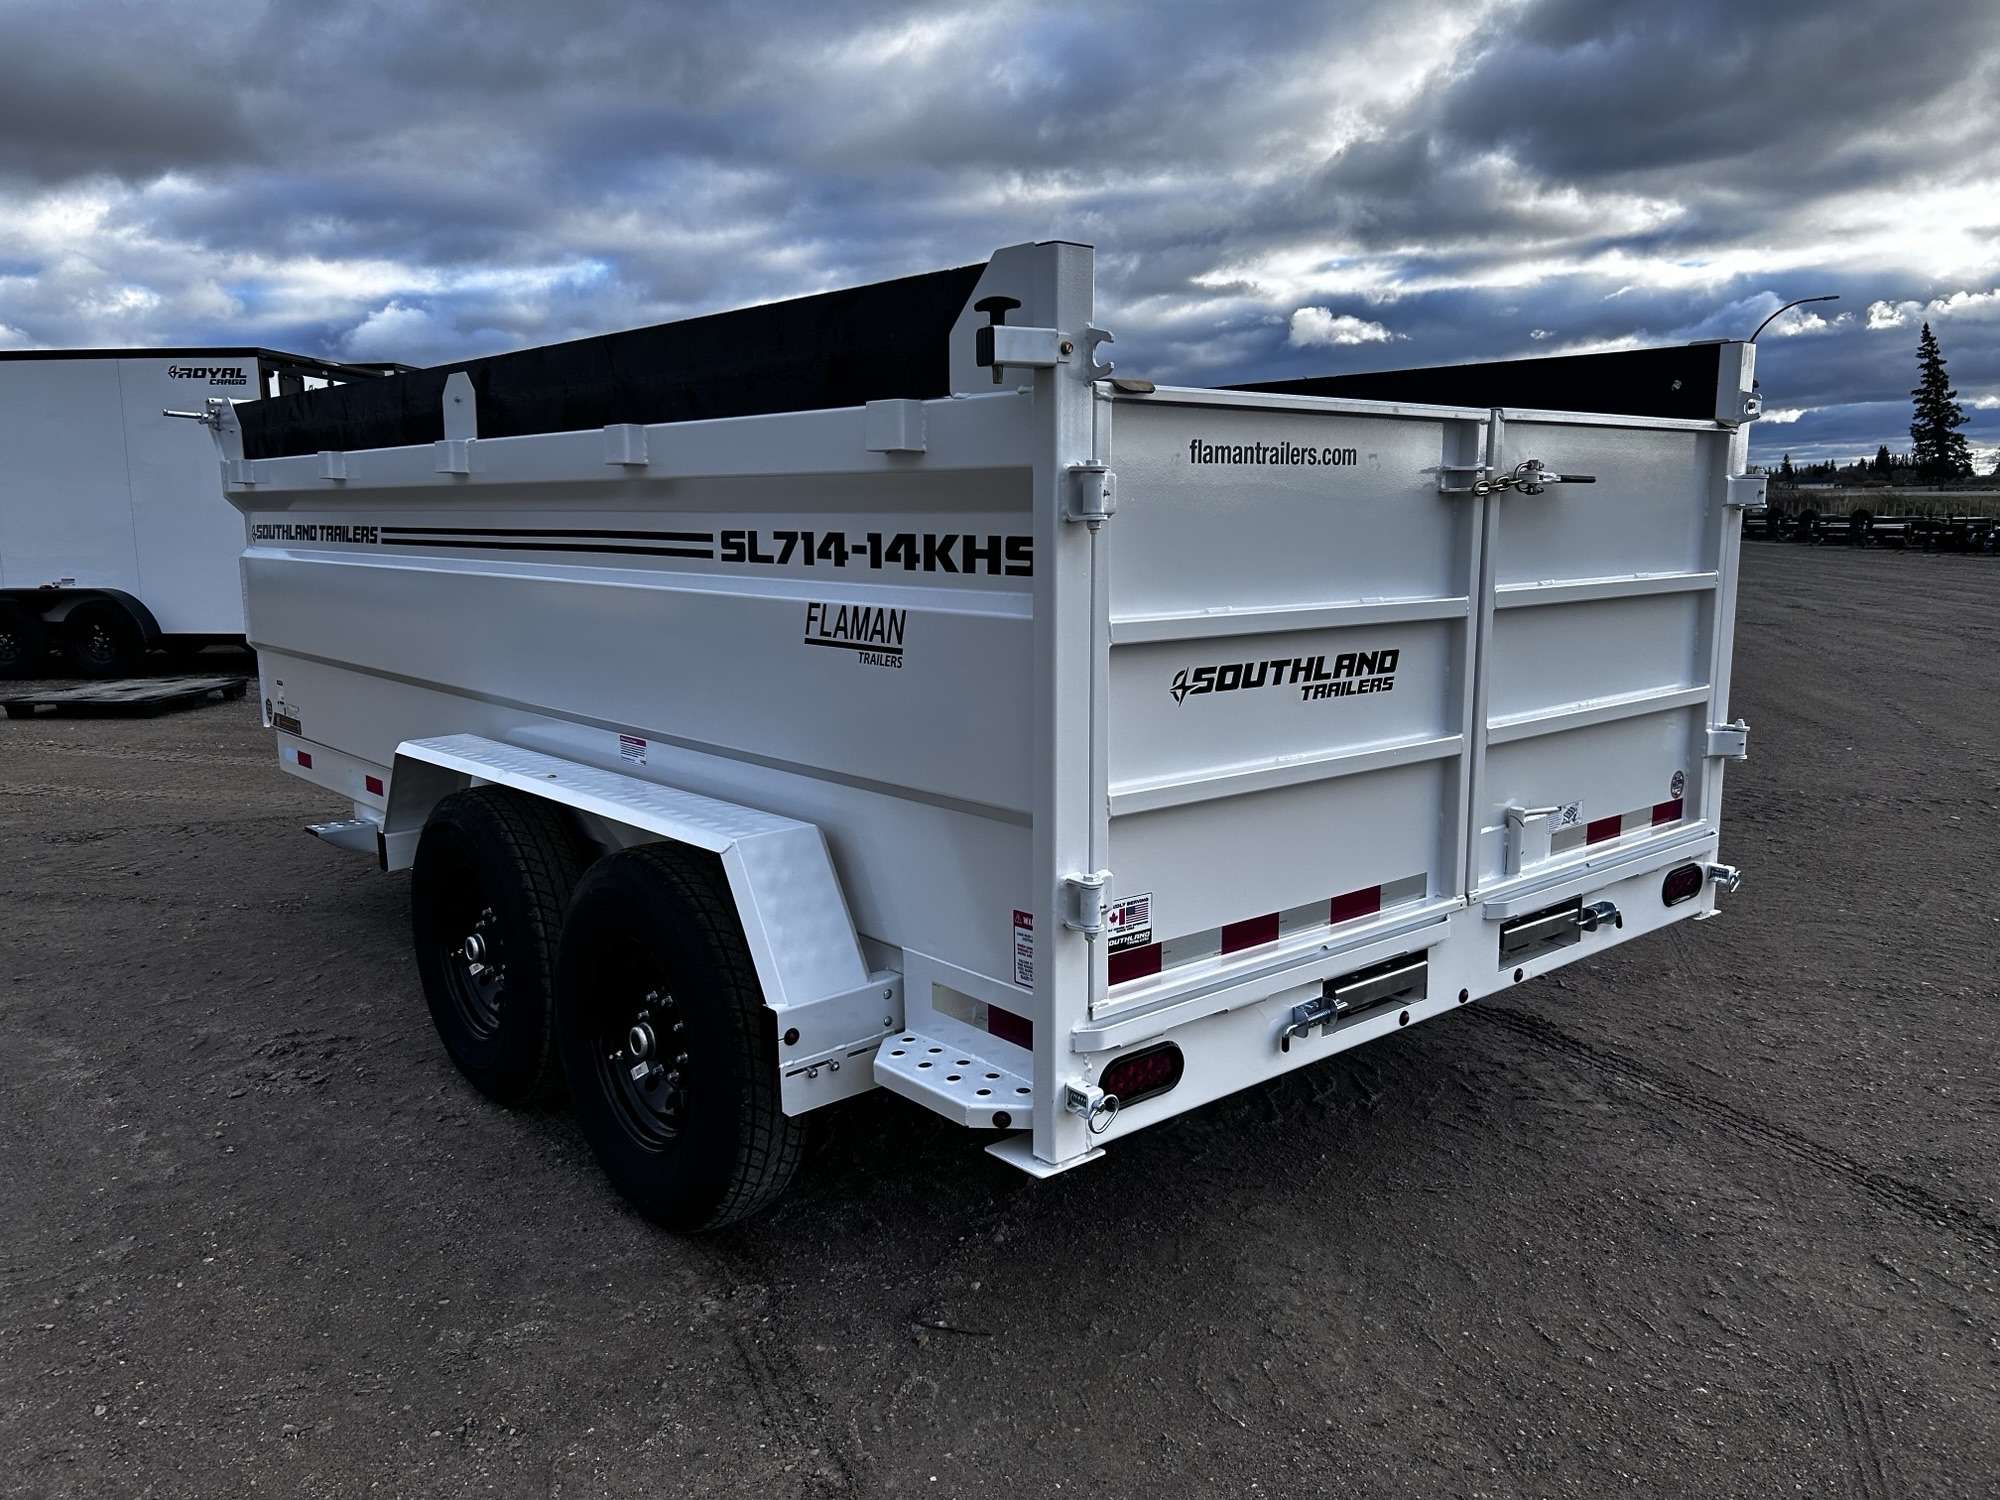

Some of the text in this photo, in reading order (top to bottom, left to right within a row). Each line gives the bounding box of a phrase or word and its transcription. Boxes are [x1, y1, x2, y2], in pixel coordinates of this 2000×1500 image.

[178, 367, 247, 379] ROYAL
[209, 378, 247, 386] CARGO
[1189, 439, 1357, 466] flamantrailers.com
[256, 524, 379, 544] SOUTHLAND TRAILERS
[720, 530, 1034, 577] SL714-14KHS
[804, 602, 907, 645] FLAMAN
[858, 651, 903, 669] TRAILERS
[1189, 649, 1400, 695] SOUTHLAND
[1301, 676, 1395, 701] TRAILERS
[1108, 931, 1150, 947] OUTHLAND
